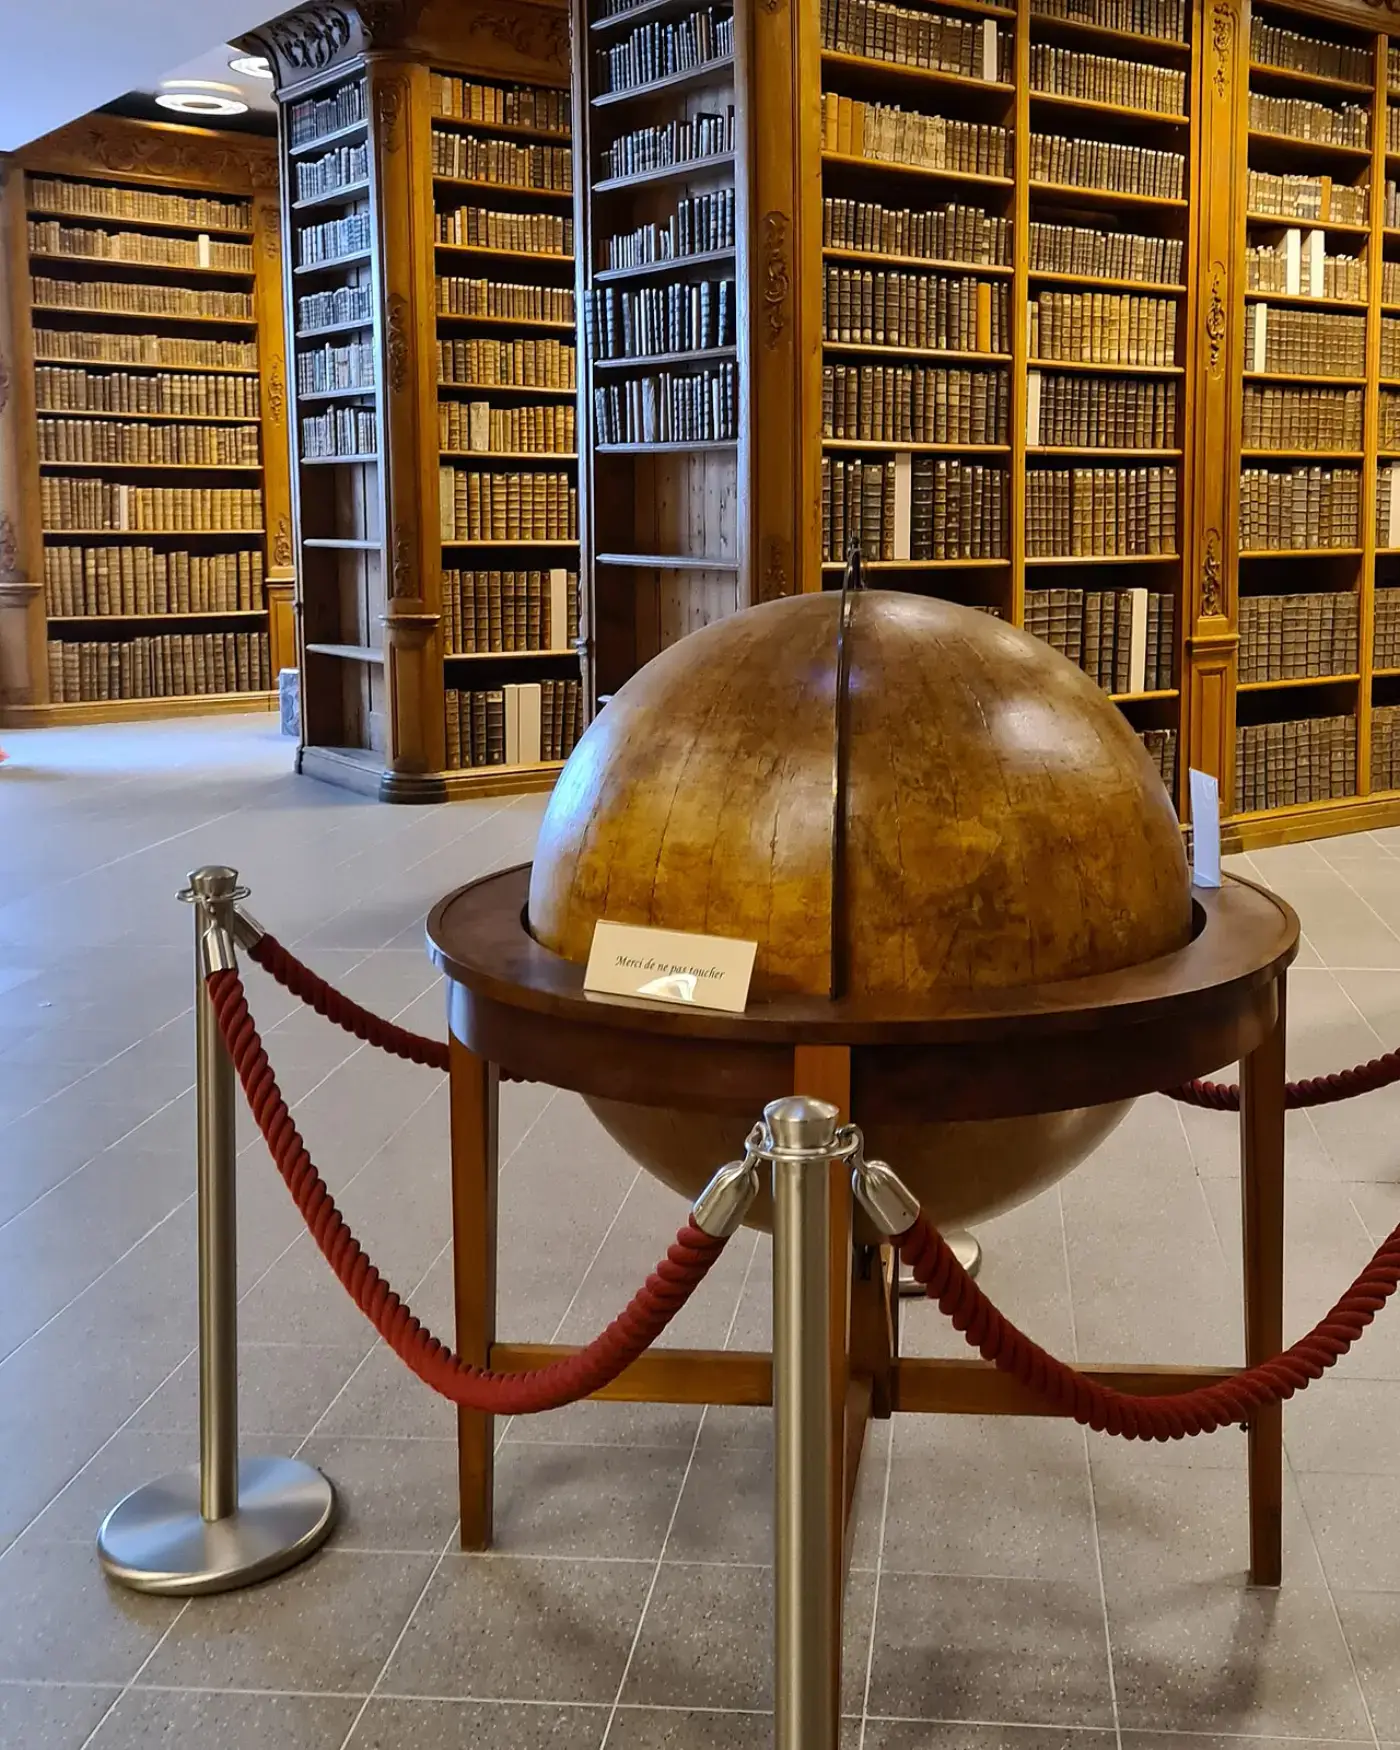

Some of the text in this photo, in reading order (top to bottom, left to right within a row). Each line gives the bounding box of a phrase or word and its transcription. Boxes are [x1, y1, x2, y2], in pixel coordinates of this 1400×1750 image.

[615, 955, 726, 980] Merci de ne pas toucher
